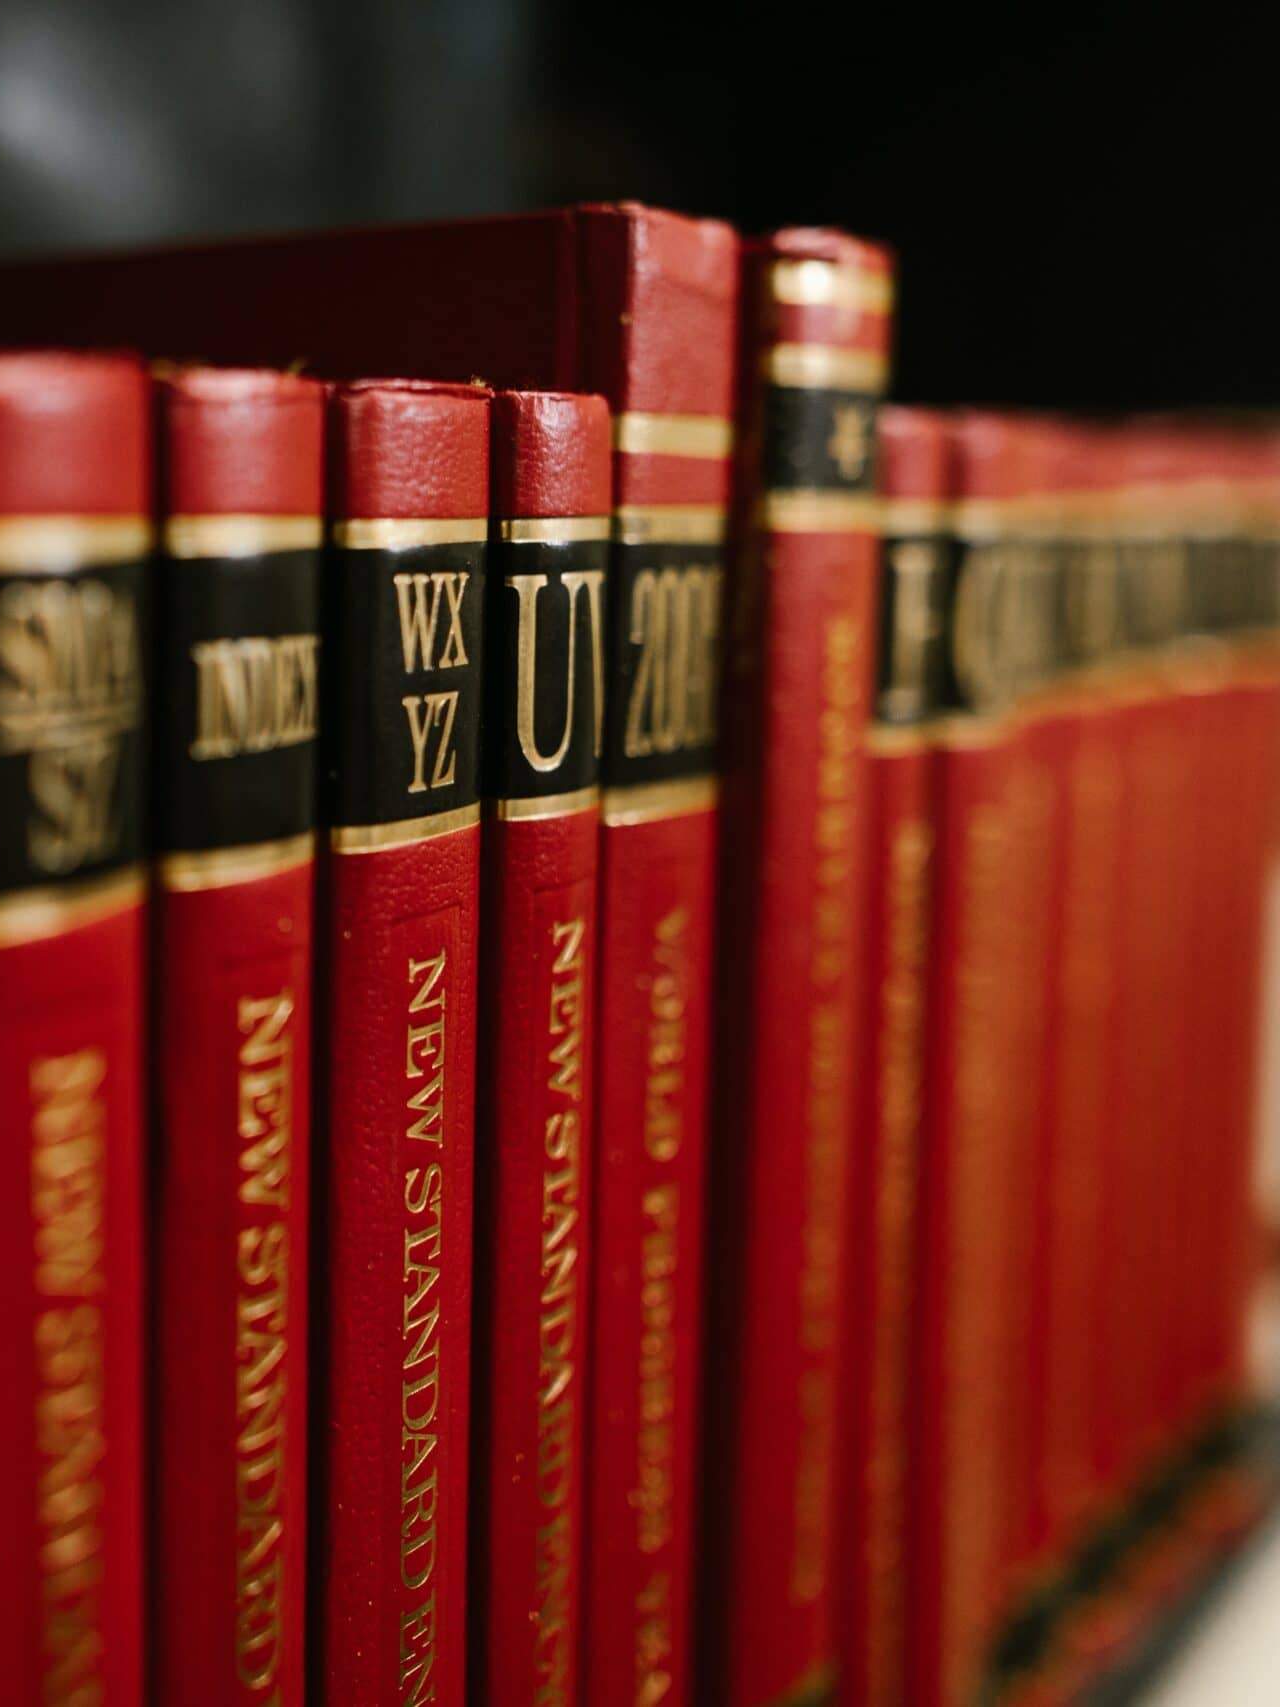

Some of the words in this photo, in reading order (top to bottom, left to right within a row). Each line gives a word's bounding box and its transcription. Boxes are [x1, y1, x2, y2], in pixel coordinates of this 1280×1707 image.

[189, 634, 320, 761] INDEX
[393, 572, 470, 673] WX
[402, 692, 459, 793] YZ
[237, 988, 294, 1208] NEW
[406, 949, 446, 1149] NEW
[547, 917, 585, 1101] NEW
[399, 1164, 442, 1589] STANDARD
[539, 1109, 579, 1508] STANDARD
[234, 1220, 288, 1689] STANDARD
